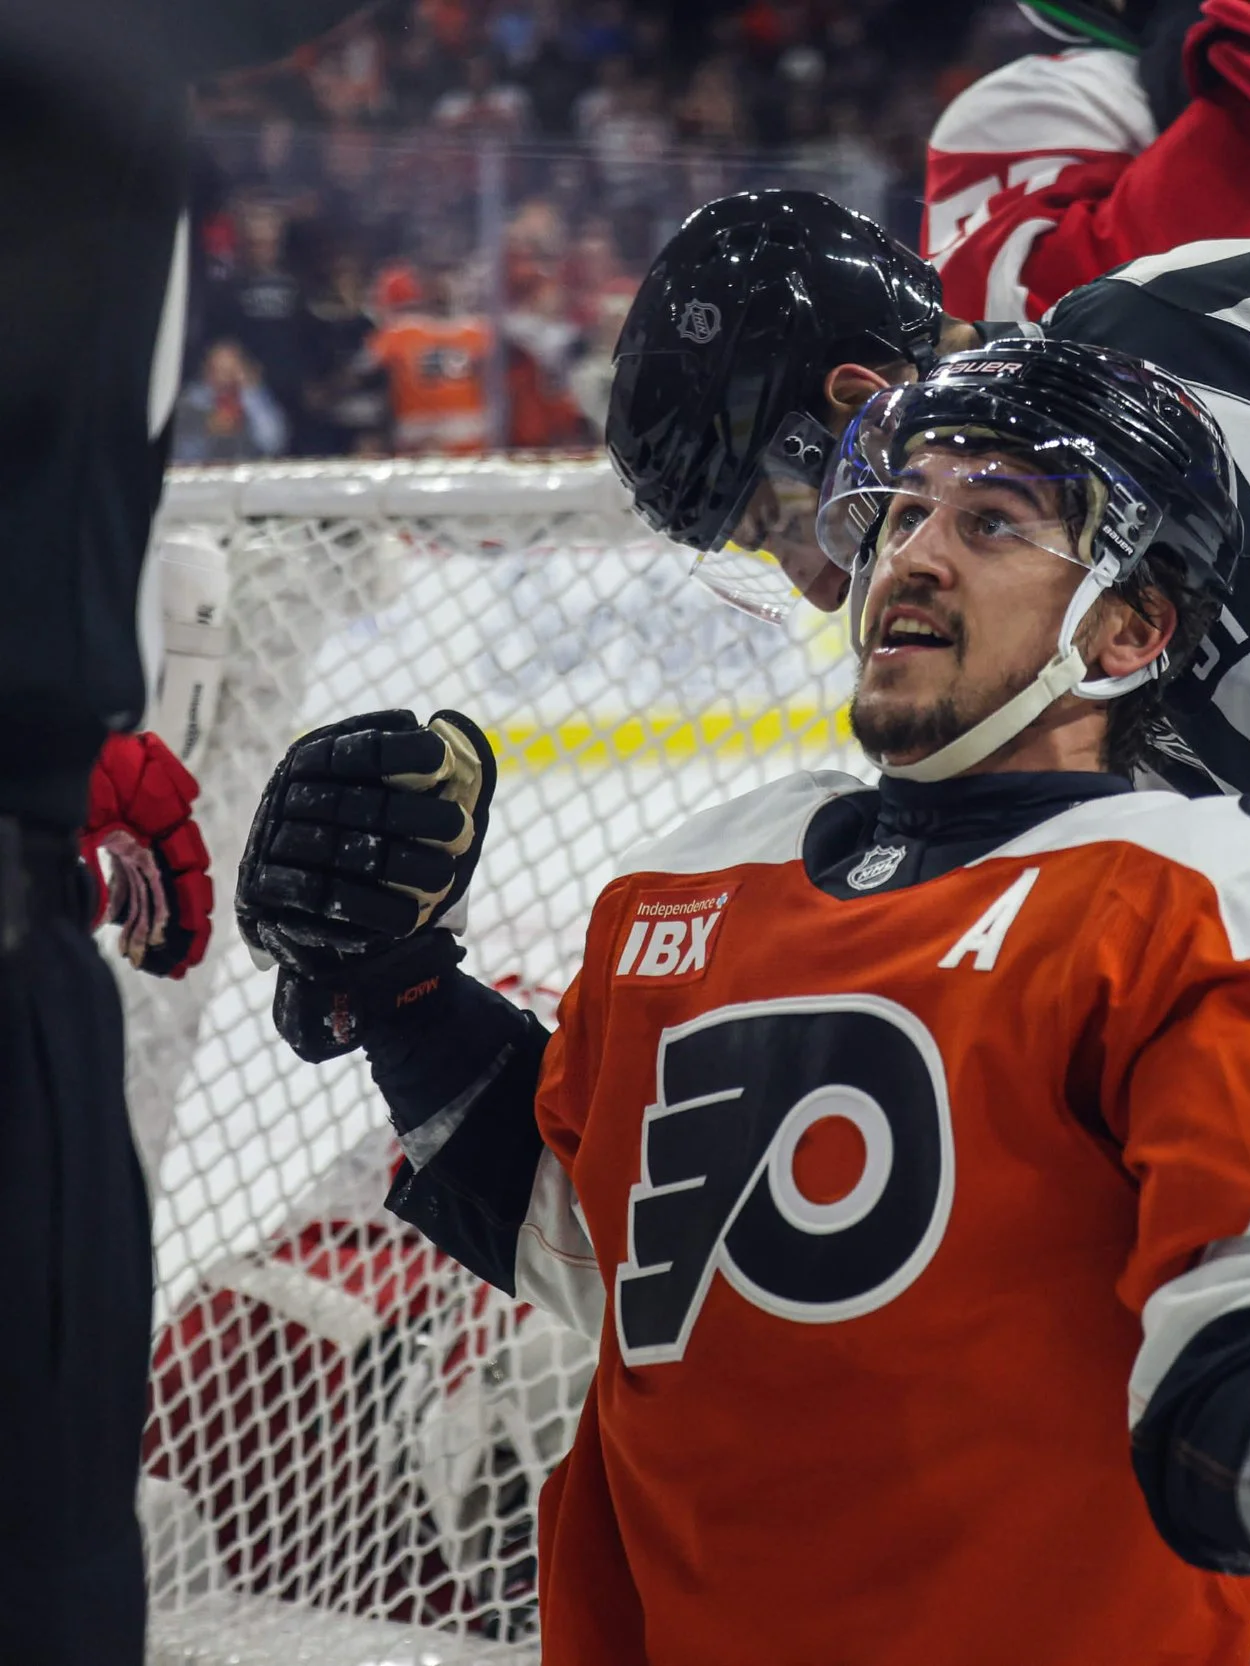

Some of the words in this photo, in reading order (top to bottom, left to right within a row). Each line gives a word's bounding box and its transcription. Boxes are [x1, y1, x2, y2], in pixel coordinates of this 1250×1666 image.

[637, 898, 716, 919] Independence
[937, 867, 1041, 972] A
[615, 911, 722, 977] IBX
